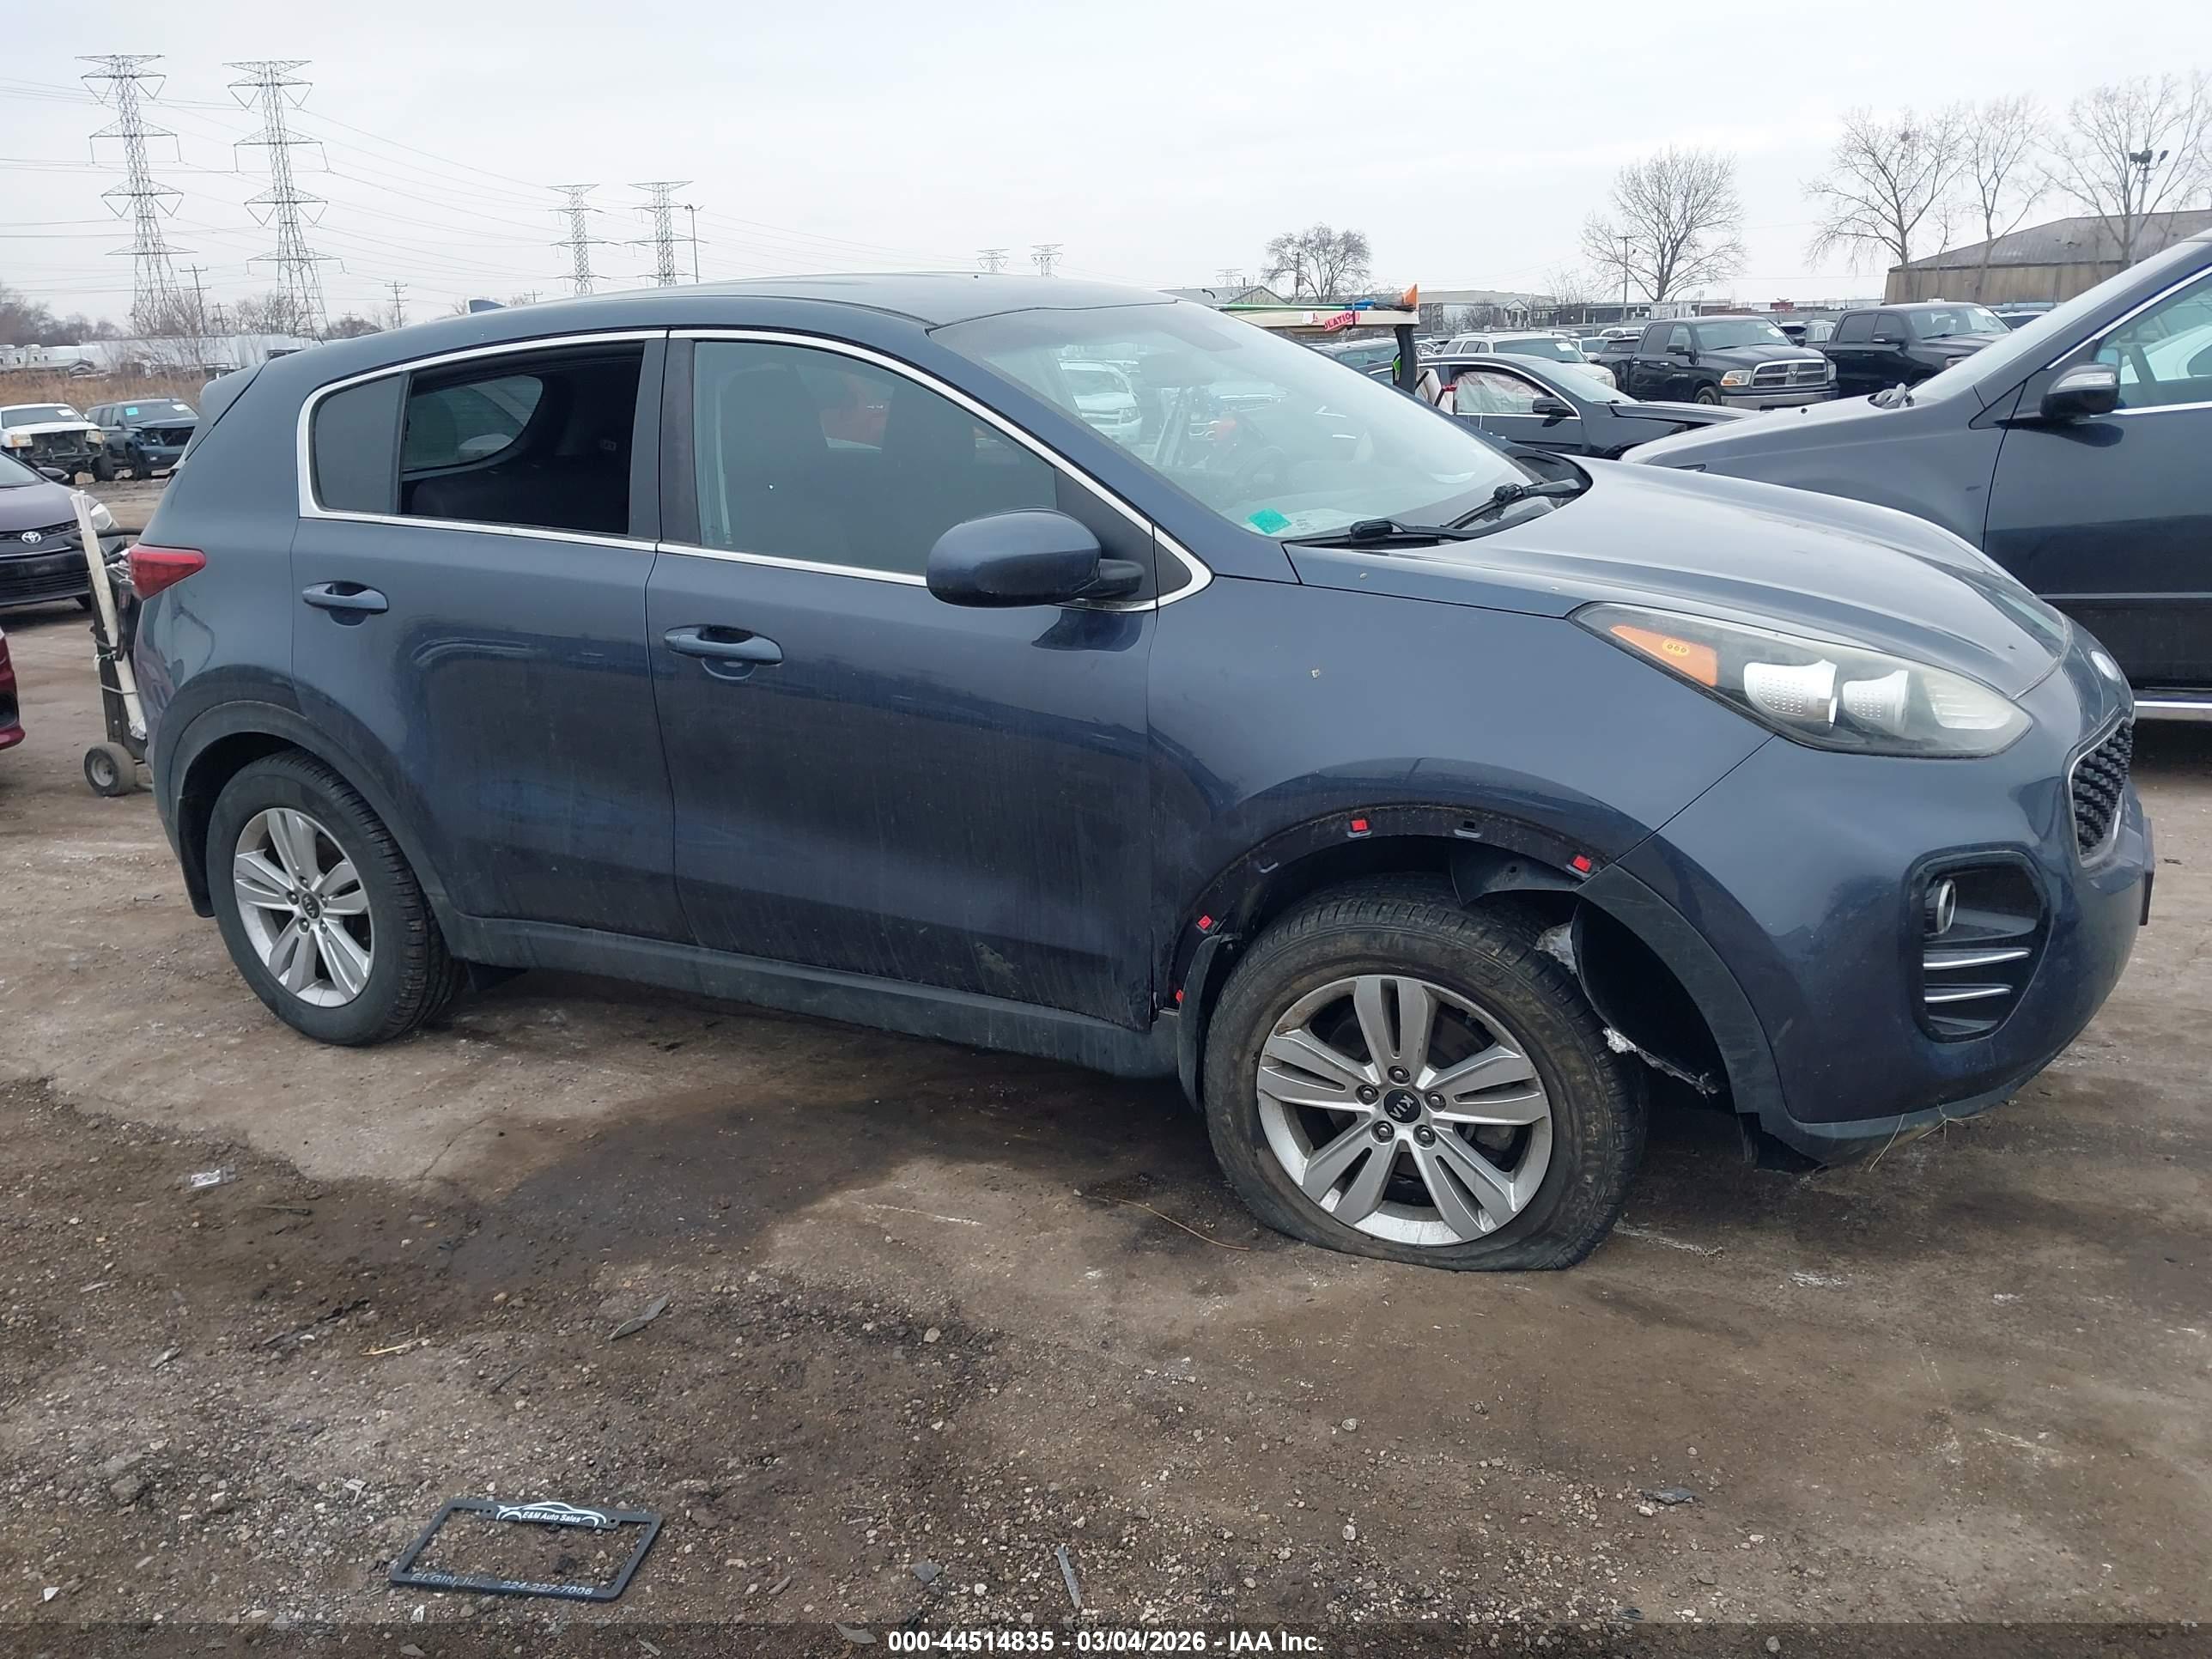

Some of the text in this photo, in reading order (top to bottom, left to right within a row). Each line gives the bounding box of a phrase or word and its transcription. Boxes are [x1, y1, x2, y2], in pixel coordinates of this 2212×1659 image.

[1389, 1095, 1415, 1119] KIA
[540, 1512, 559, 1521] Auto
[560, 1514, 581, 1523] Sales
[410, 1572, 475, 1588] ELGIN, IL
[501, 1581, 594, 1595] 224-227-7006
